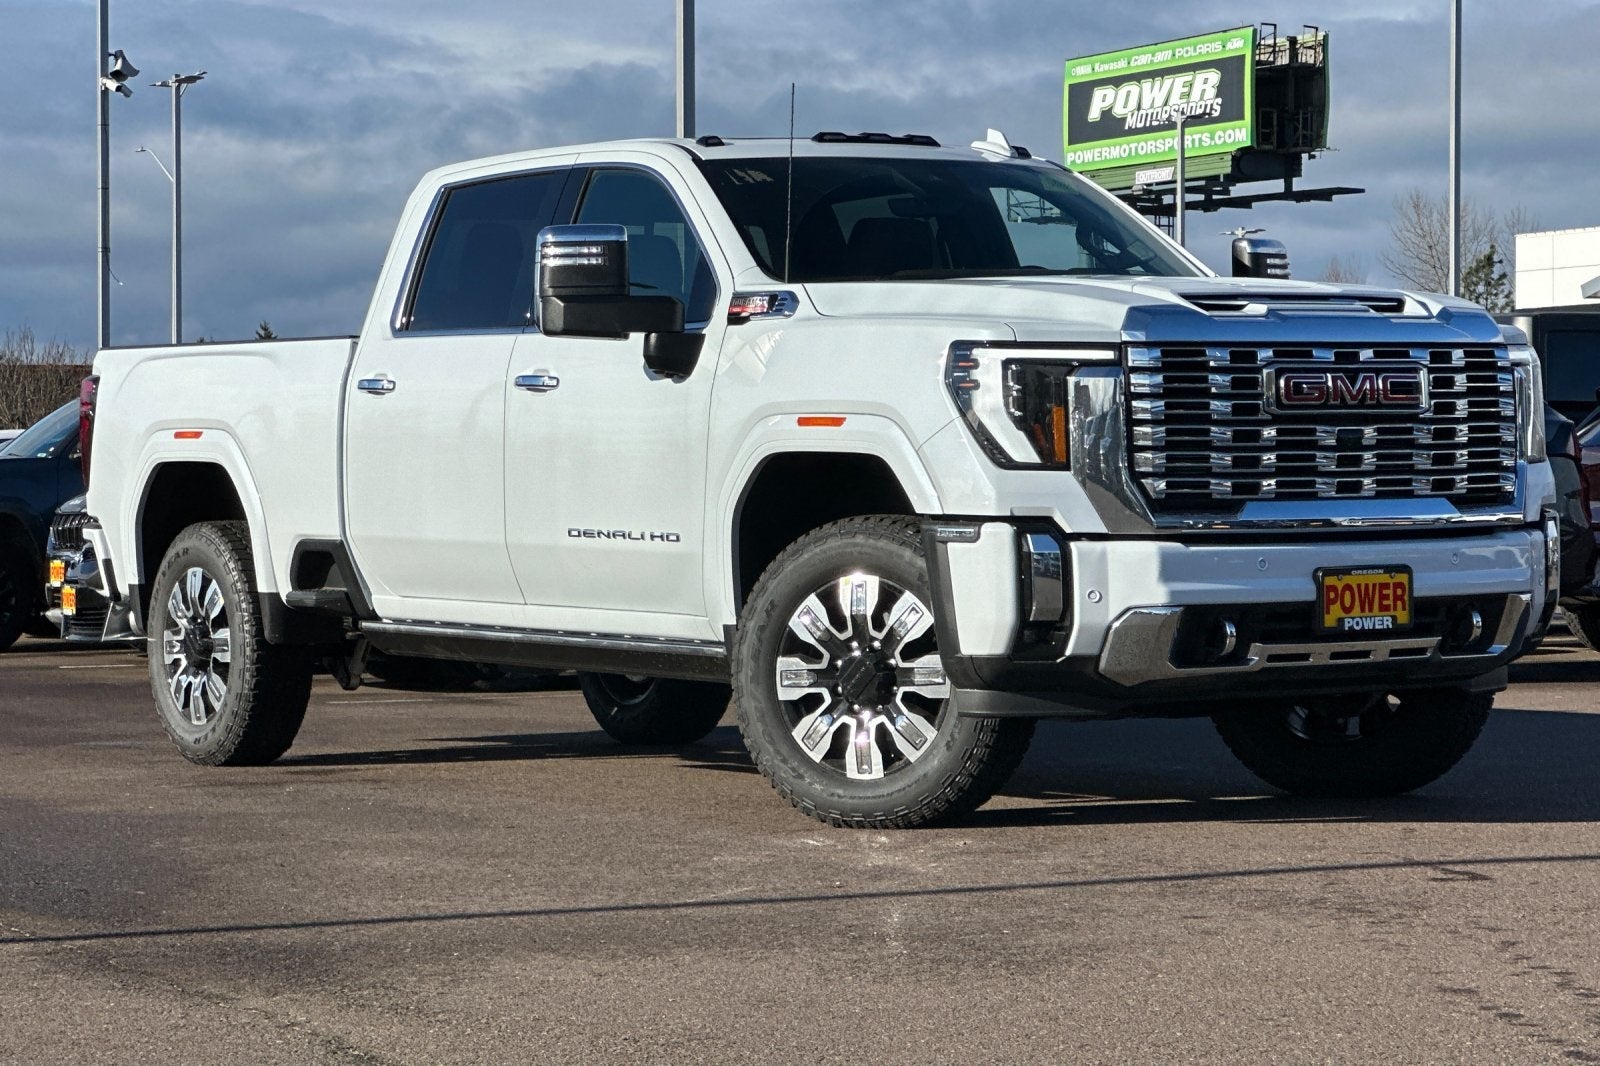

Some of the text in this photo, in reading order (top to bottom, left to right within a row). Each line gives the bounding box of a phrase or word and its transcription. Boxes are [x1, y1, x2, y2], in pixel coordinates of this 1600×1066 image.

[1094, 57, 1128, 73] Kawasaki
[1130, 49, 1173, 67] can-am
[1175, 41, 1223, 59] POLARIS
[1087, 68, 1222, 122] POWER
[1279, 372, 1421, 405] GMC
[567, 528, 681, 542] DENALI HD
[1324, 581, 1407, 616] POWER
[1344, 616, 1393, 631] POWER
